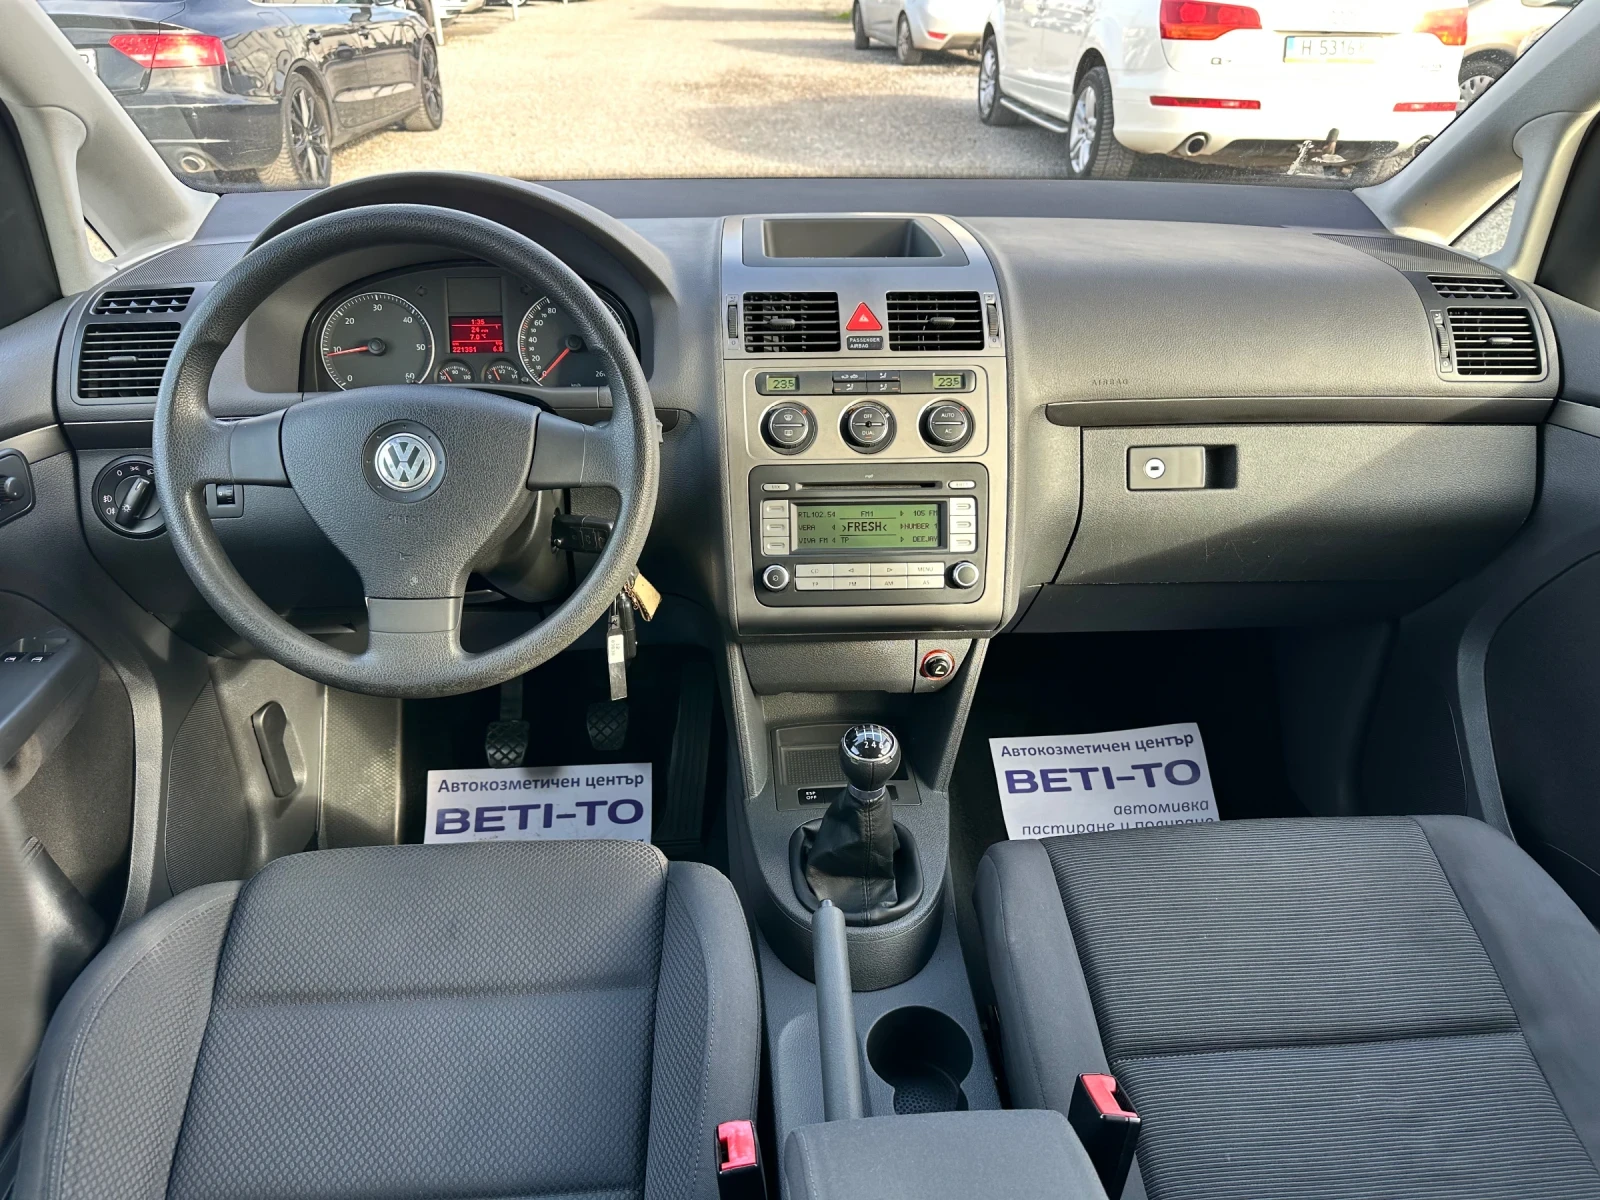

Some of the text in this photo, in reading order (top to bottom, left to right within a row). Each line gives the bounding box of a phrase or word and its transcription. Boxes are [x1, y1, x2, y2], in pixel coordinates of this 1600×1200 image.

[1302, 40, 1312, 56] H
[372, 304, 383, 312] 30
[773, 379, 795, 389] 23.5
[938, 378, 960, 387] 23.5
[1001, 732, 1194, 758] Автокозметичен център
[438, 774, 644, 792] Автокозметичен център
[1004, 759, 1200, 794] BETI-TO
[1113, 800, 1209, 816] автомивка
[435, 799, 644, 835] BETI-TO
